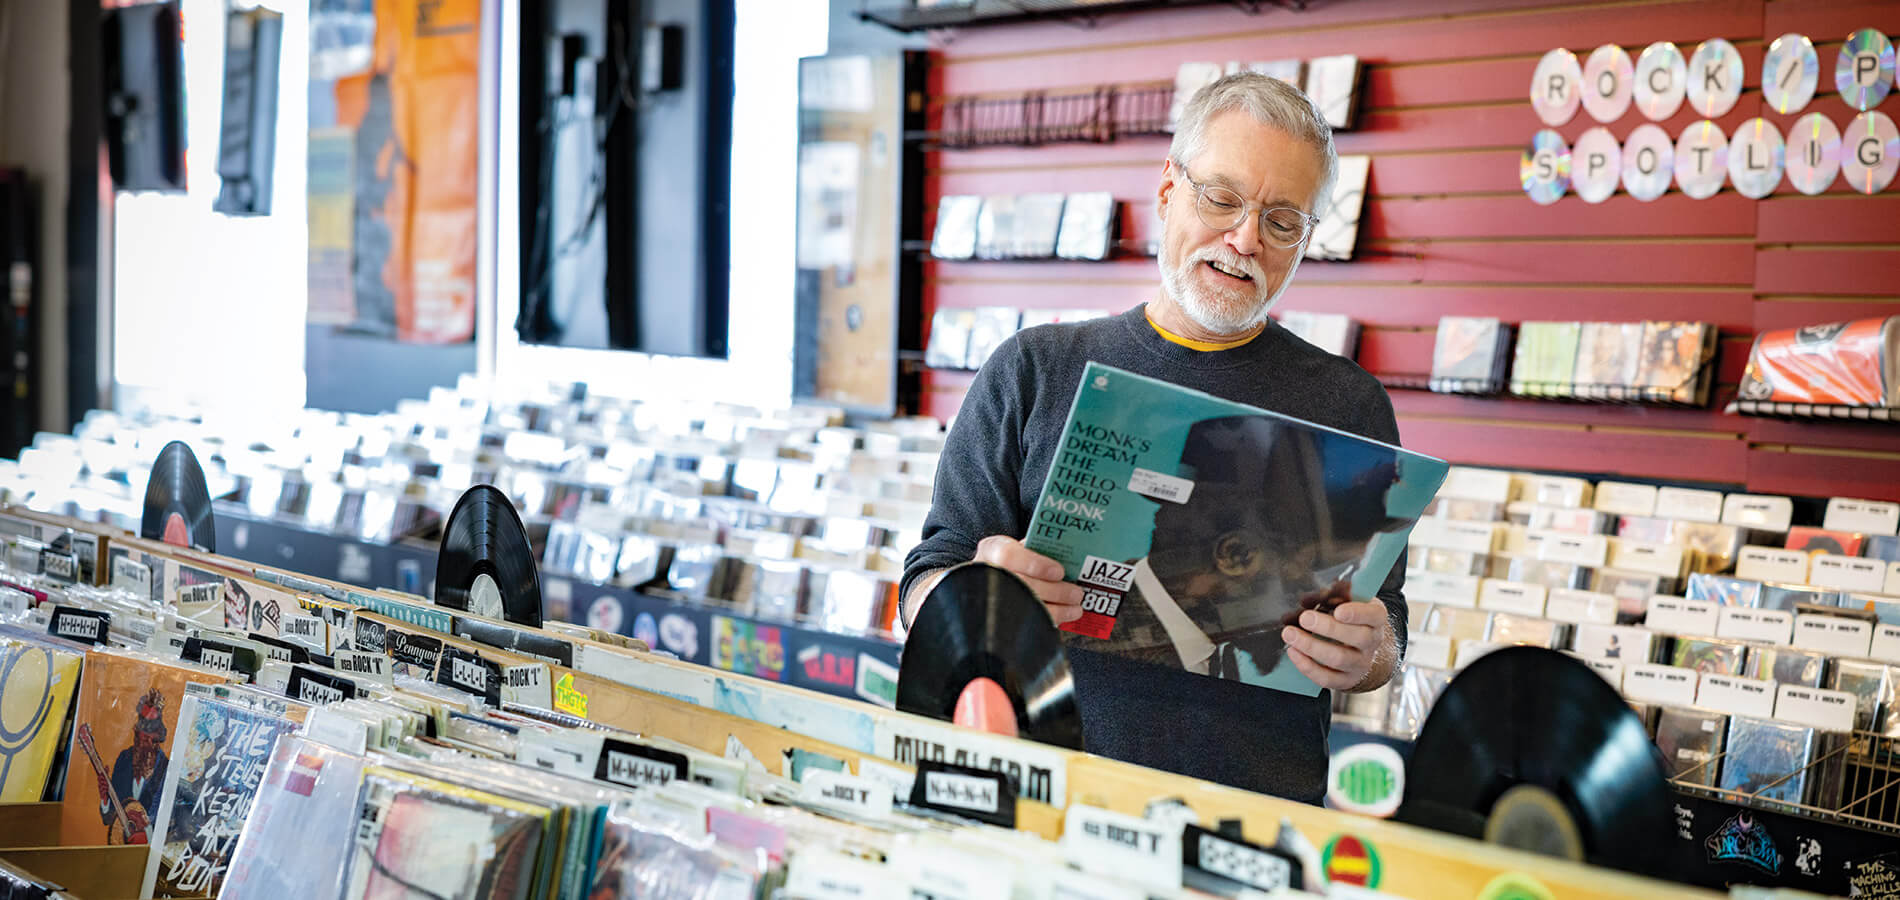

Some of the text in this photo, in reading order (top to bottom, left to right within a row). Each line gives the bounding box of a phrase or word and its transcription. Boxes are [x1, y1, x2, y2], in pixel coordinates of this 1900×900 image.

[1547, 64, 1724, 100] ROCK
[1071, 420, 1152, 454] MONK'S
[1061, 451, 1099, 472] THE
[1066, 436, 1138, 466] DREAM
[1056, 466, 1123, 492] THELO-
[1050, 480, 1112, 506] NIOUS
[1043, 495, 1106, 521] MONK
[1036, 523, 1067, 540] TET
[1040, 509, 1100, 533] QUAR-
[1081, 559, 1134, 583] JAZZ
[294, 618, 311, 636] ROCK
[341, 659, 352, 671] USED
[352, 655, 372, 674] ROCK
[509, 668, 530, 688] ROCK
[226, 717, 275, 757] THE
[205, 746, 266, 790] STEVE
[195, 815, 244, 857] ART
[1850, 870, 1896, 887] MACHINE
[1857, 860, 1885, 876] THIS
